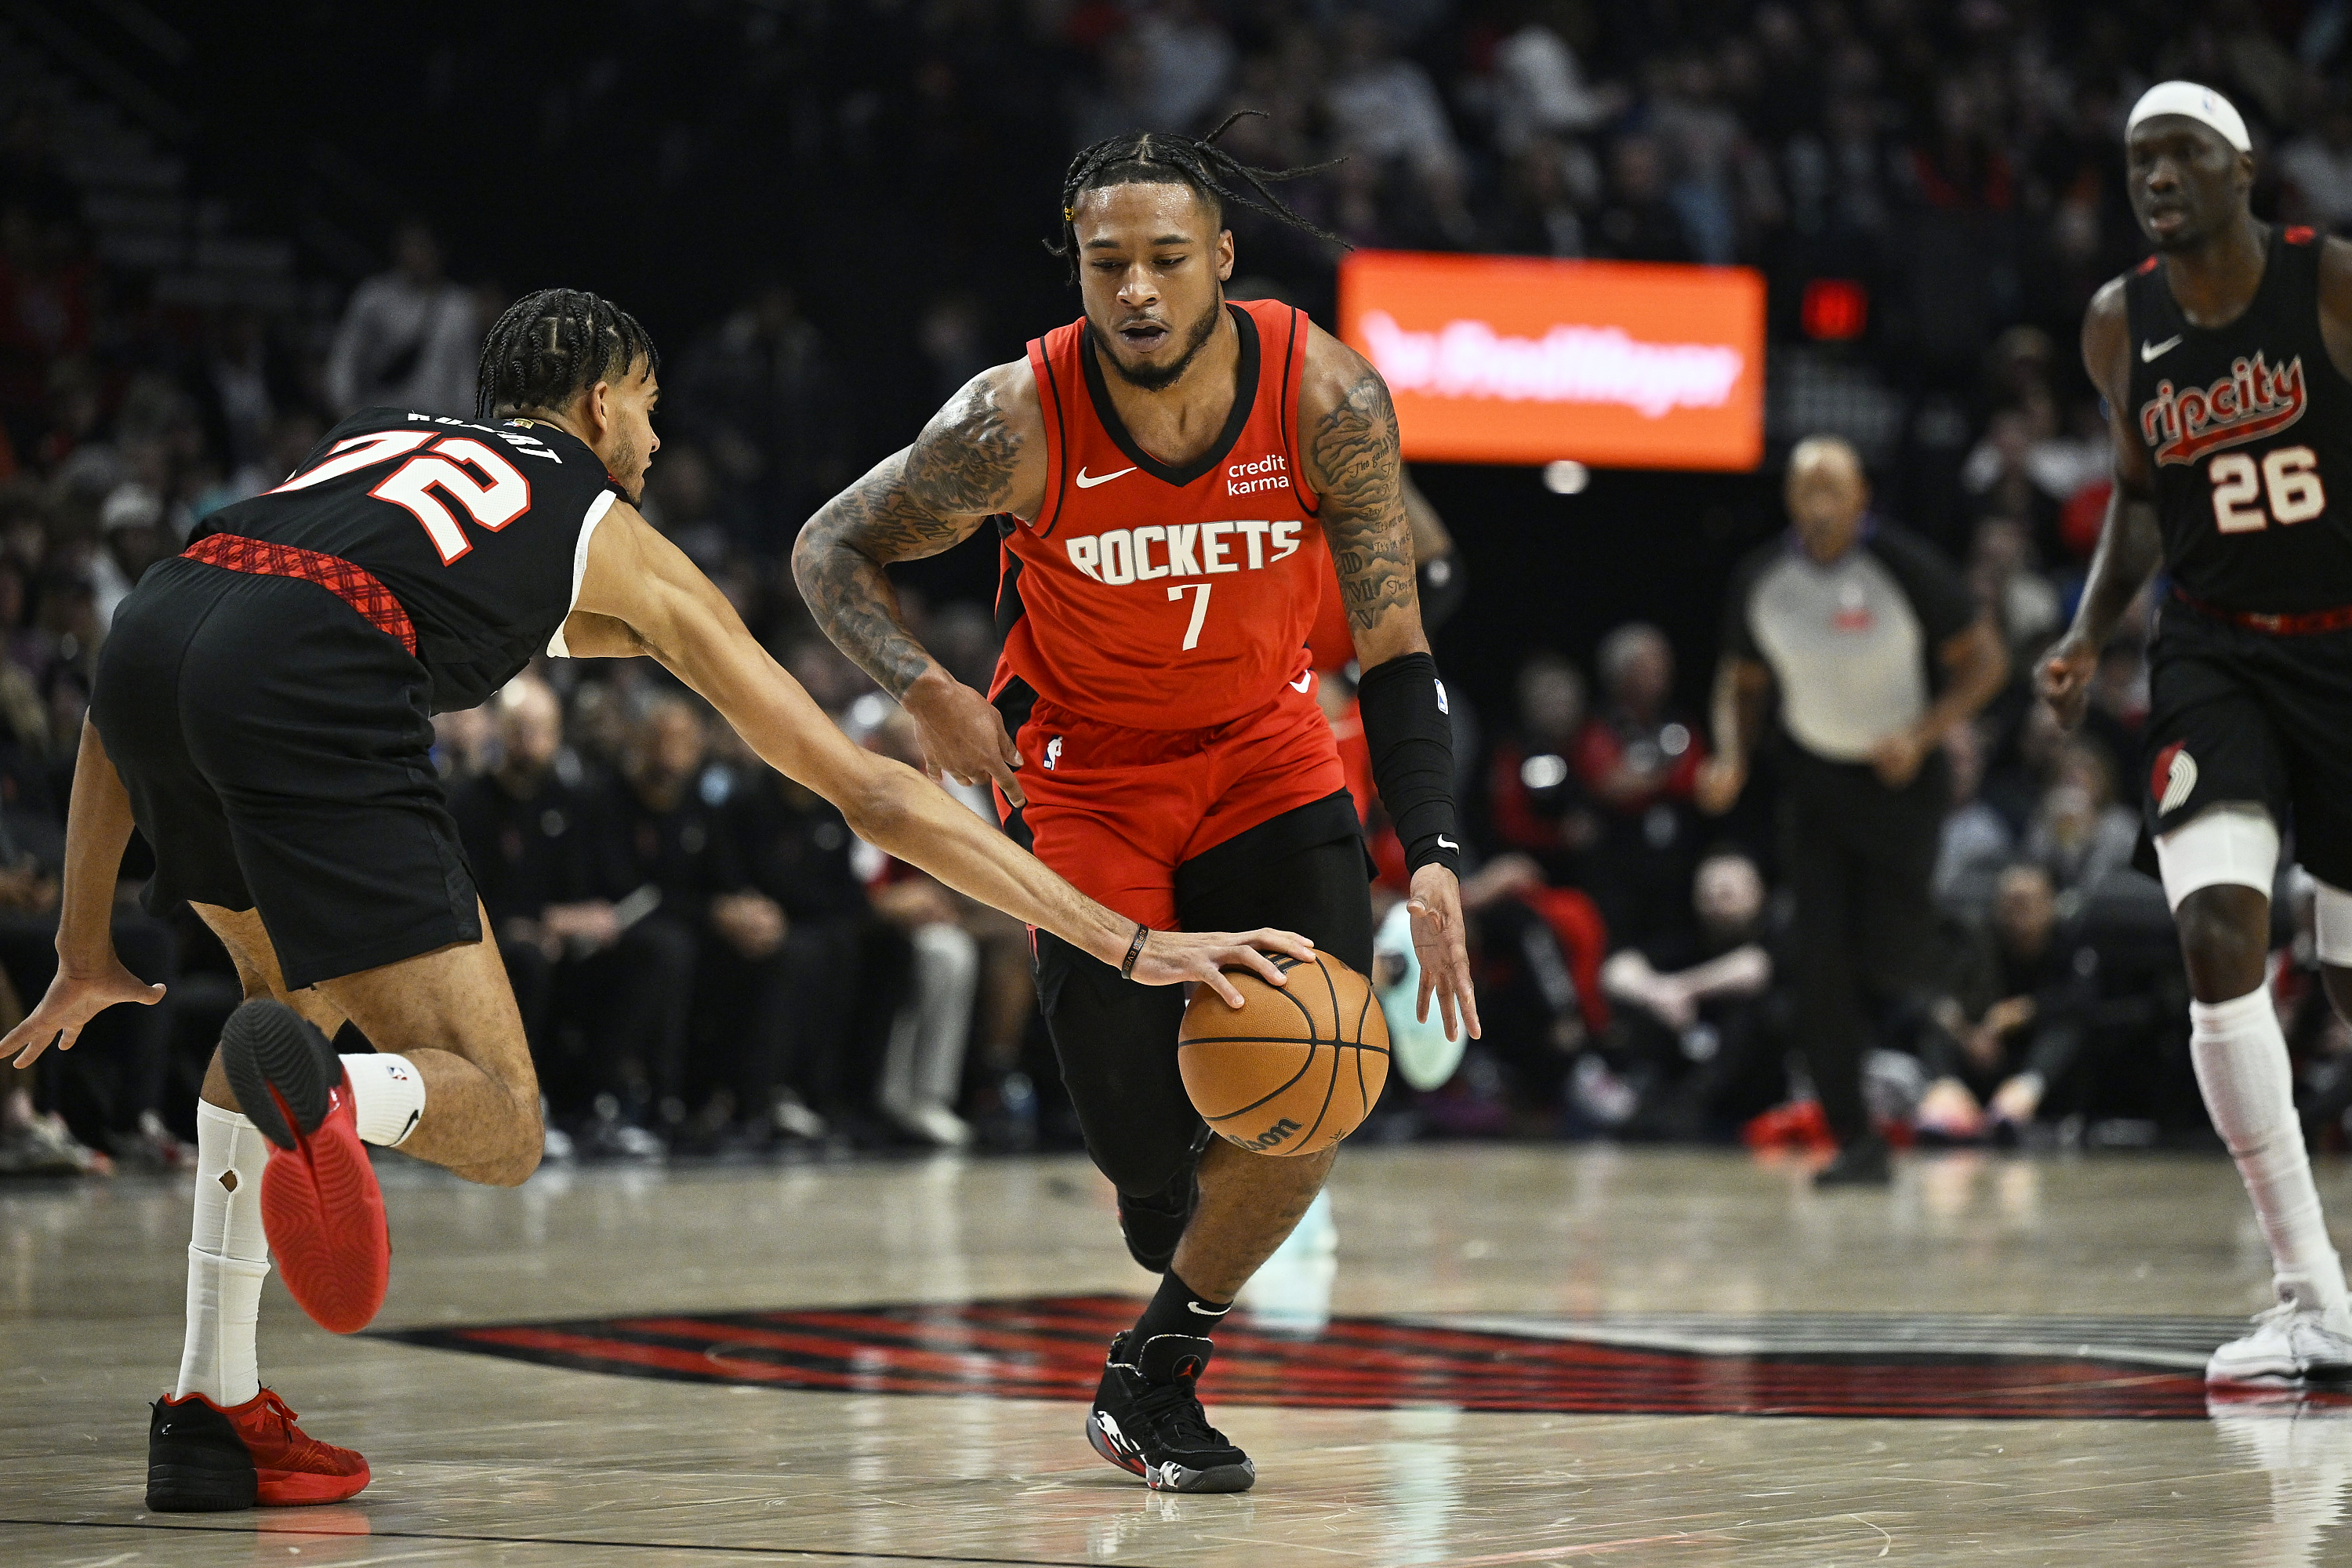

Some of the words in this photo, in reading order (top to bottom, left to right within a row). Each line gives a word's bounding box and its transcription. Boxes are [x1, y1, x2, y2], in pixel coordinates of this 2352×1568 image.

[260, 430, 532, 567] 72
[1226, 474, 1290, 496] karma
[1228, 454, 1287, 477] credit
[2209, 445, 2327, 535] 26
[1065, 520, 1303, 586] ROCKETS
[1167, 583, 1212, 652] 7
[1123, 950, 1136, 971] EVER
